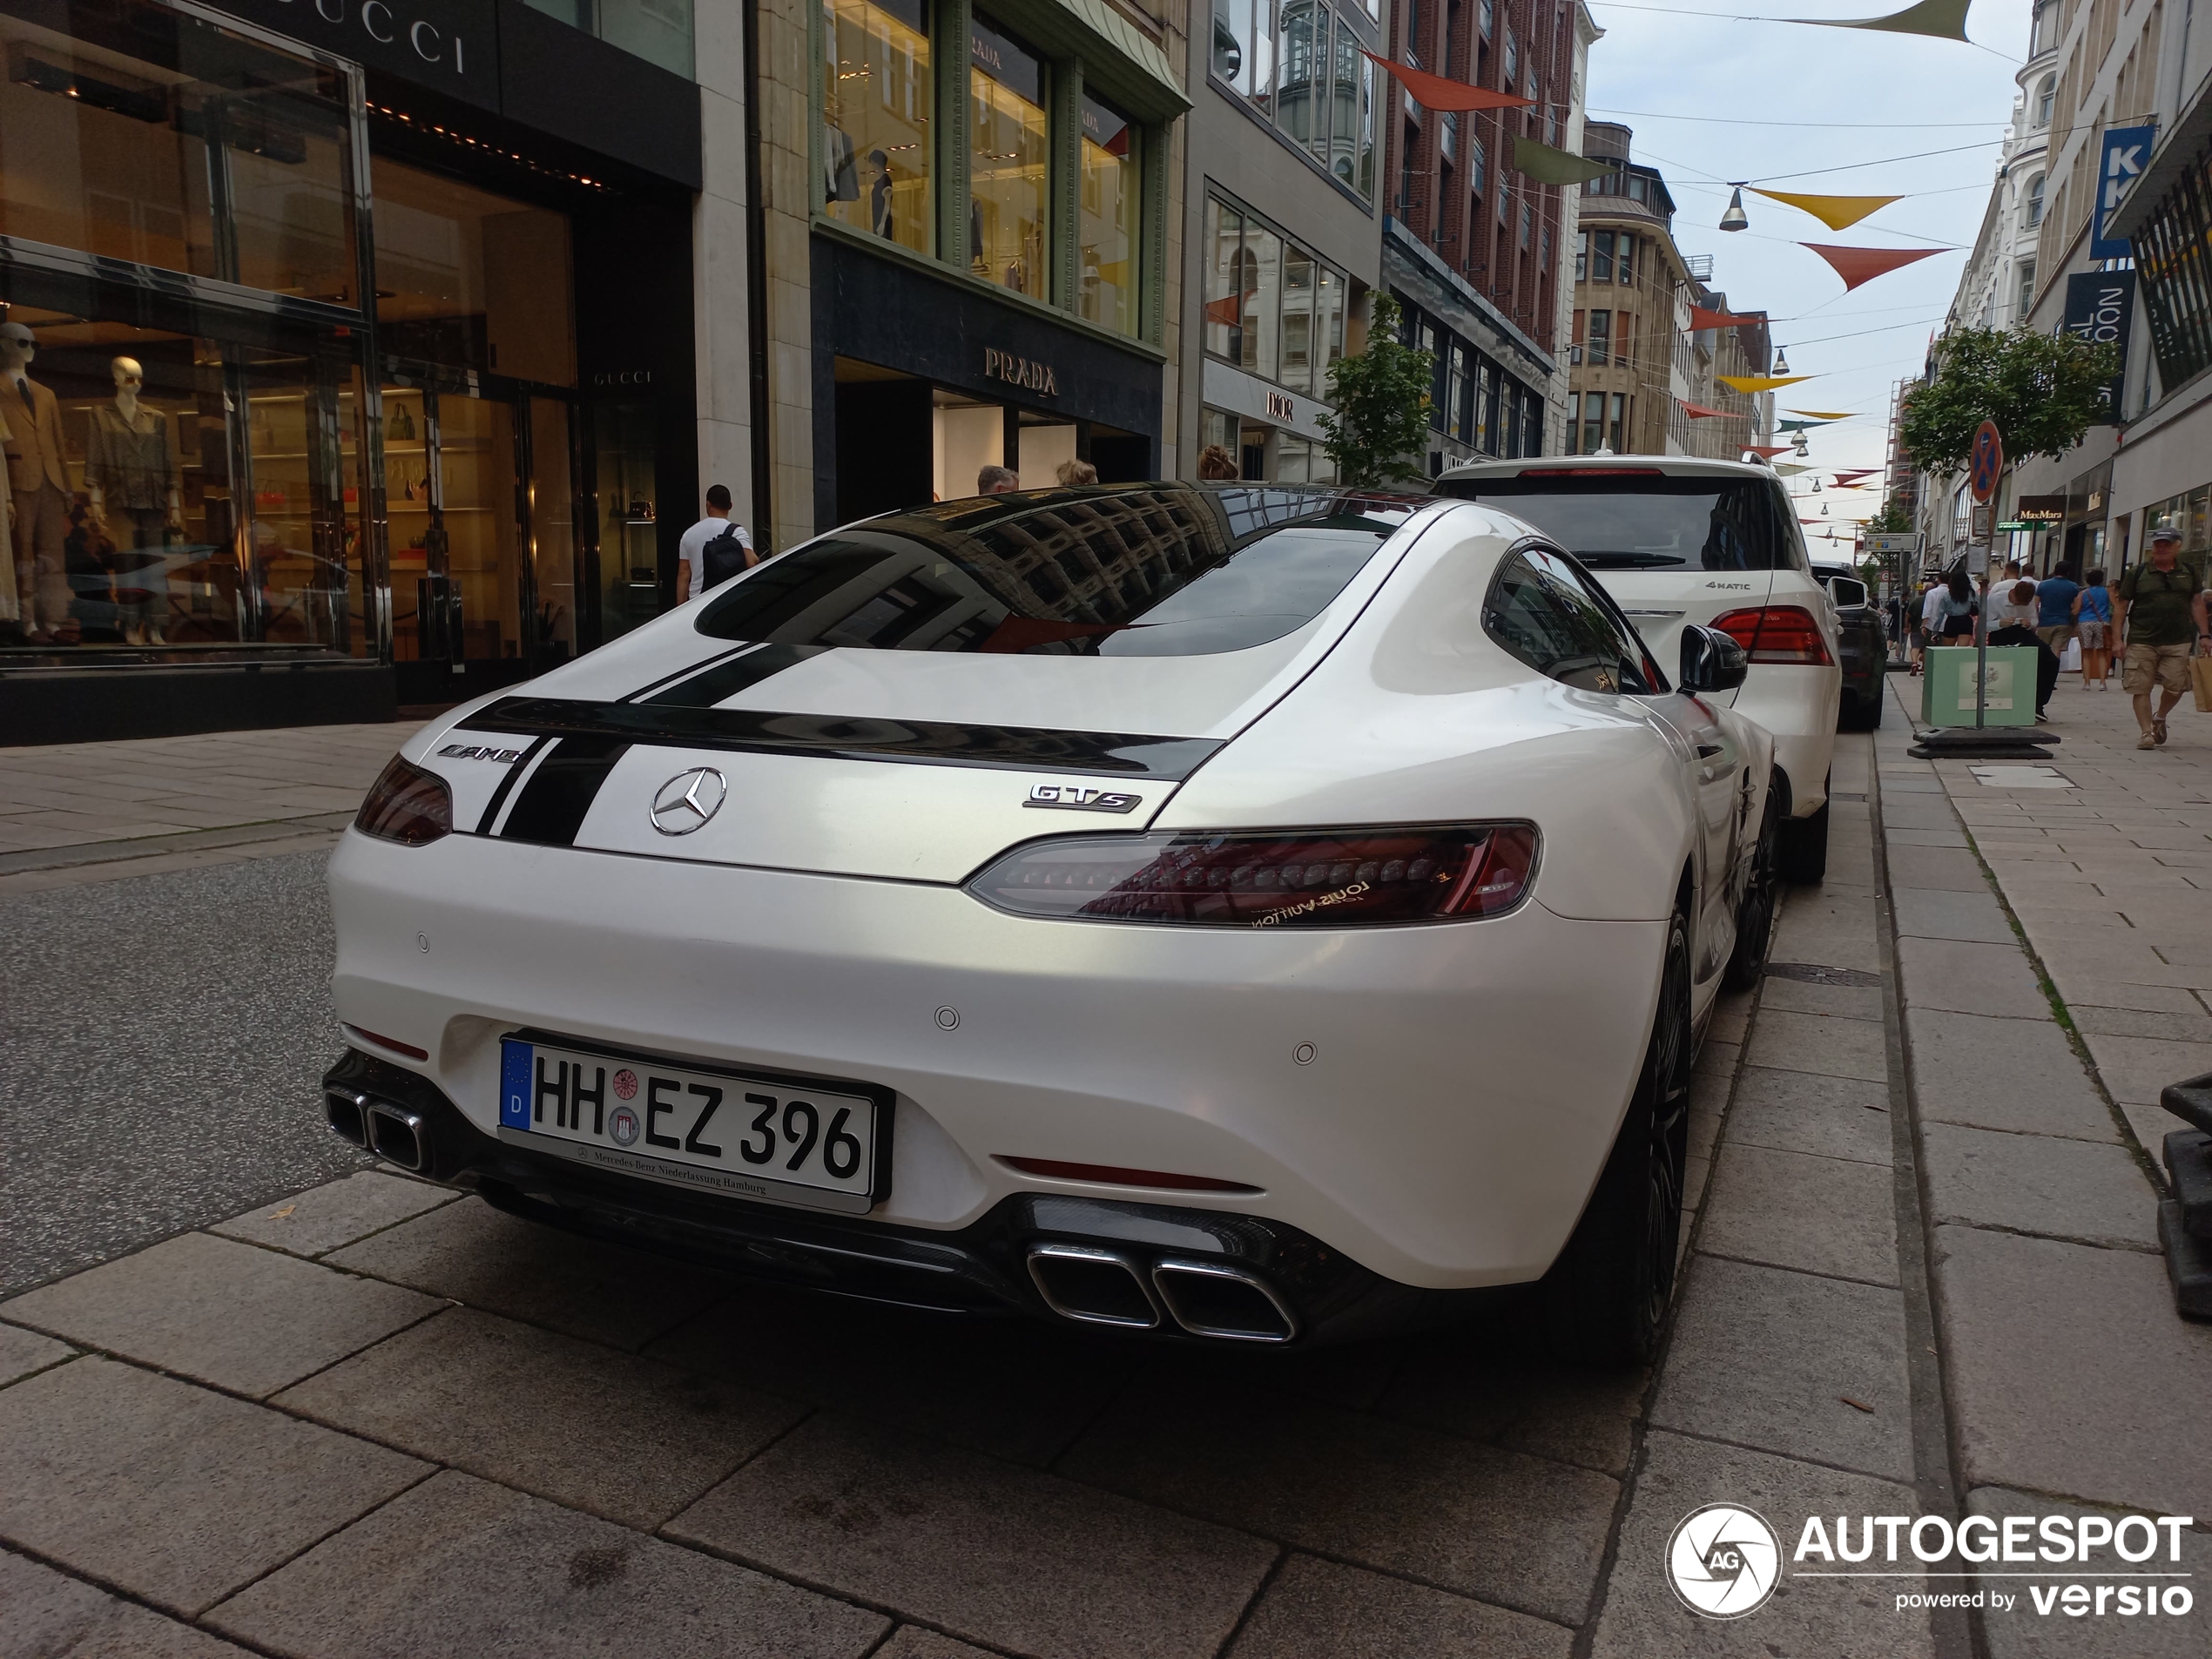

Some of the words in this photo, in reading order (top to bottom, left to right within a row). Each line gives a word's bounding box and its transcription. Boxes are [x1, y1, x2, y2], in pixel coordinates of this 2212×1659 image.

[277, 0, 464, 74] UCCI
[594, 370, 651, 386] GUCCI
[985, 347, 1059, 396] PRADA
[1266, 391, 1294, 423] DIOR
[2020, 509, 2062, 520] MaxMara
[1705, 581, 1751, 591] 4MATIC
[511, 1095, 522, 1114] D
[535, 1056, 607, 1135] HH
[645, 1076, 723, 1158] EZ
[740, 1092, 862, 1179] 396
[595, 1152, 656, 1173] Mercedes-Benz
[658, 1165, 721, 1188] Niederlassung
[724, 1177, 766, 1196] Hamburg
